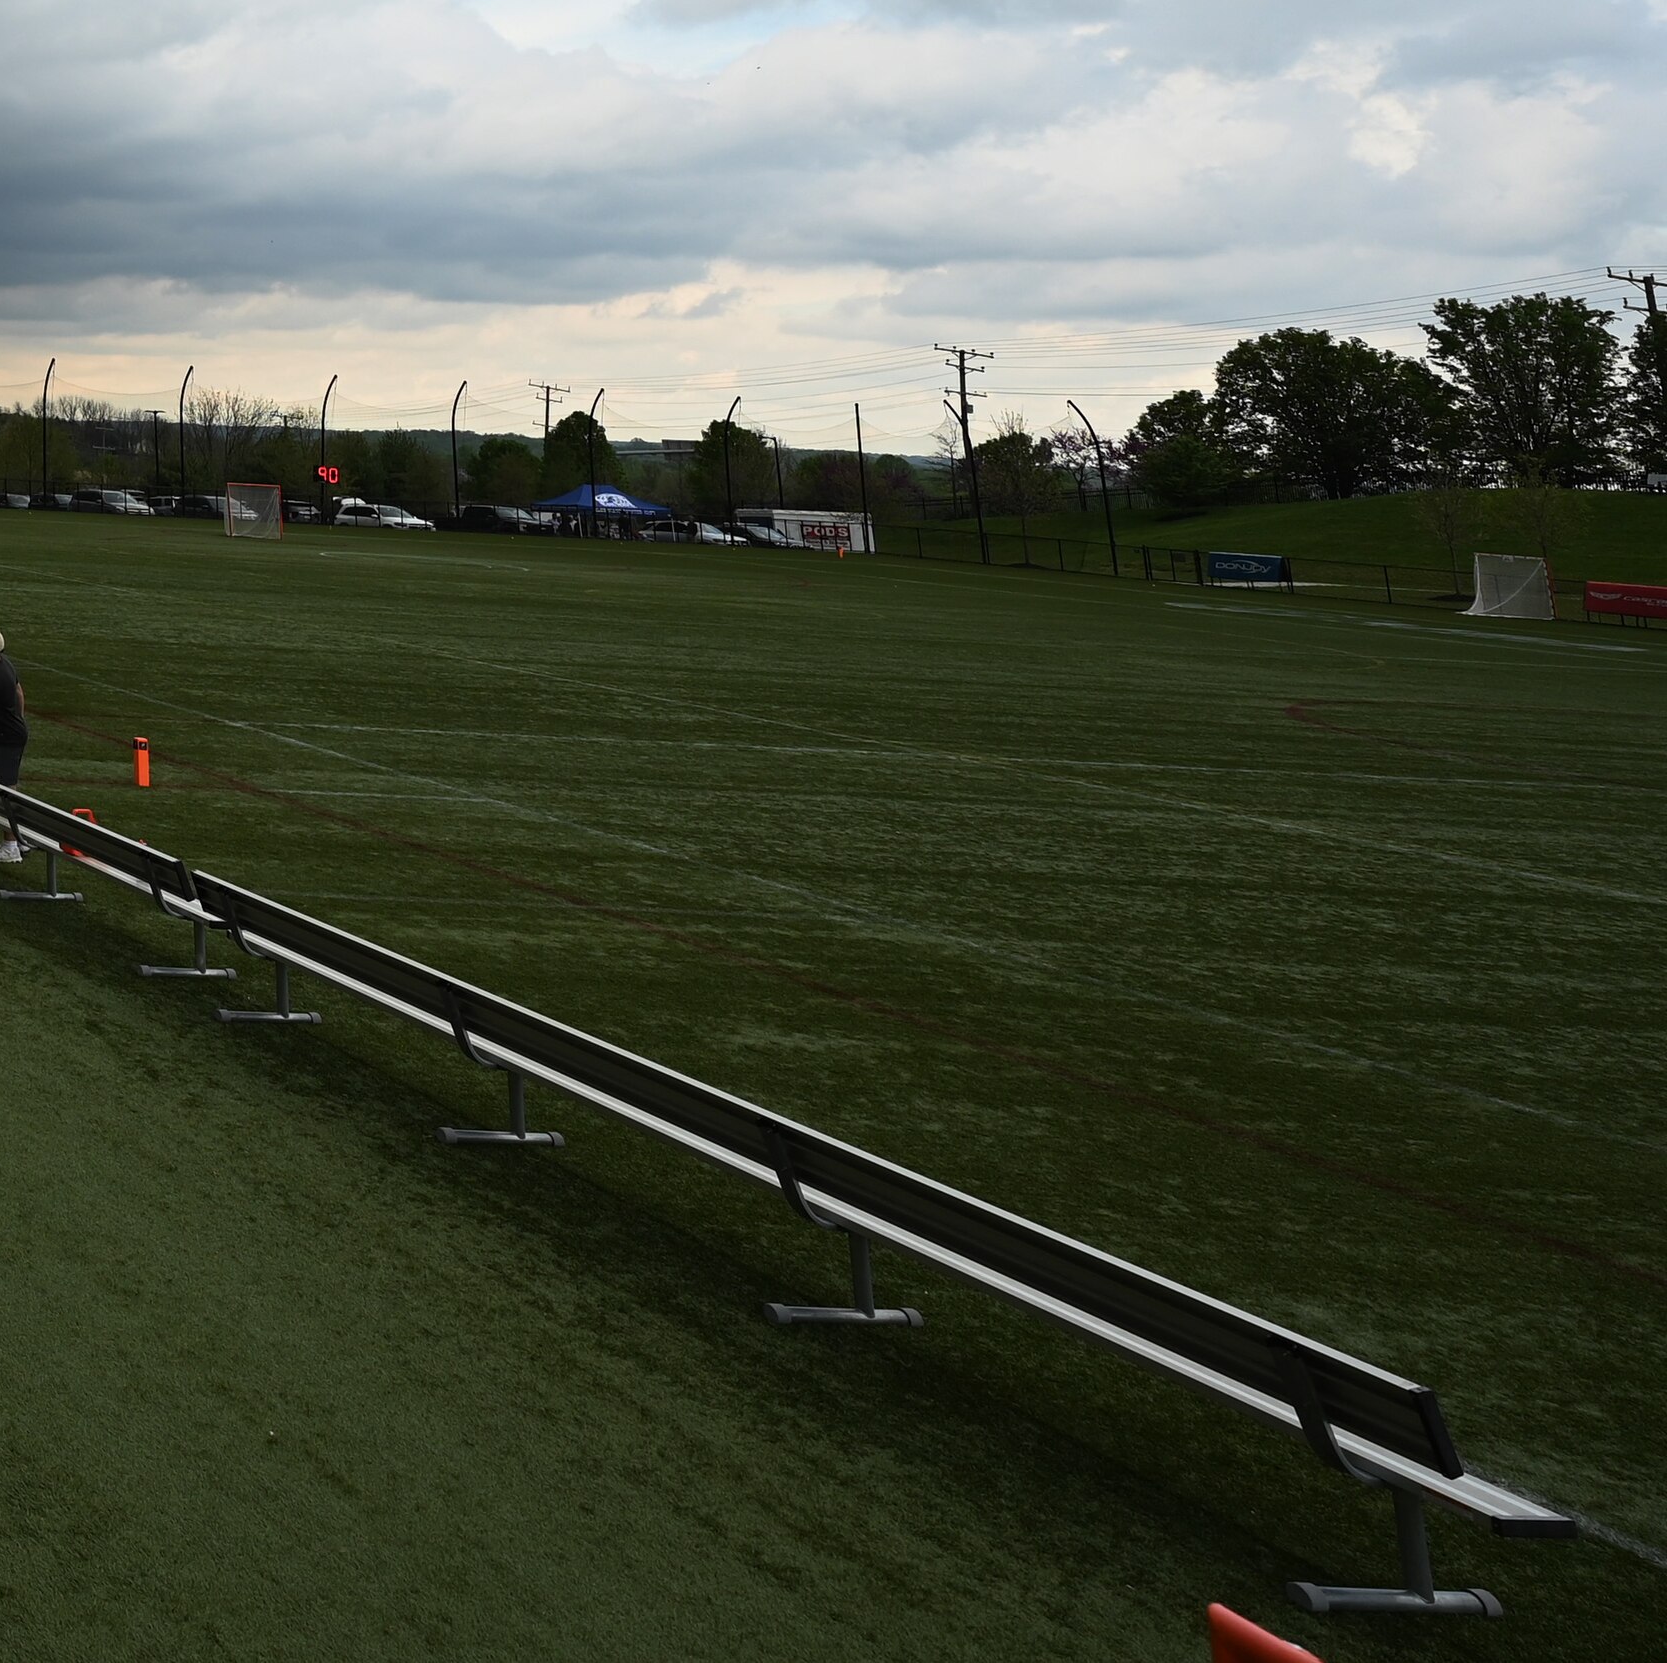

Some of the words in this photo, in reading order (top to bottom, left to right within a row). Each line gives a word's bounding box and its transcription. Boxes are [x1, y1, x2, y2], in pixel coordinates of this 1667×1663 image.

[318, 467, 338, 483] 90
[803, 526, 849, 537] PODS
[1215, 561, 1272, 574] DONJOY
